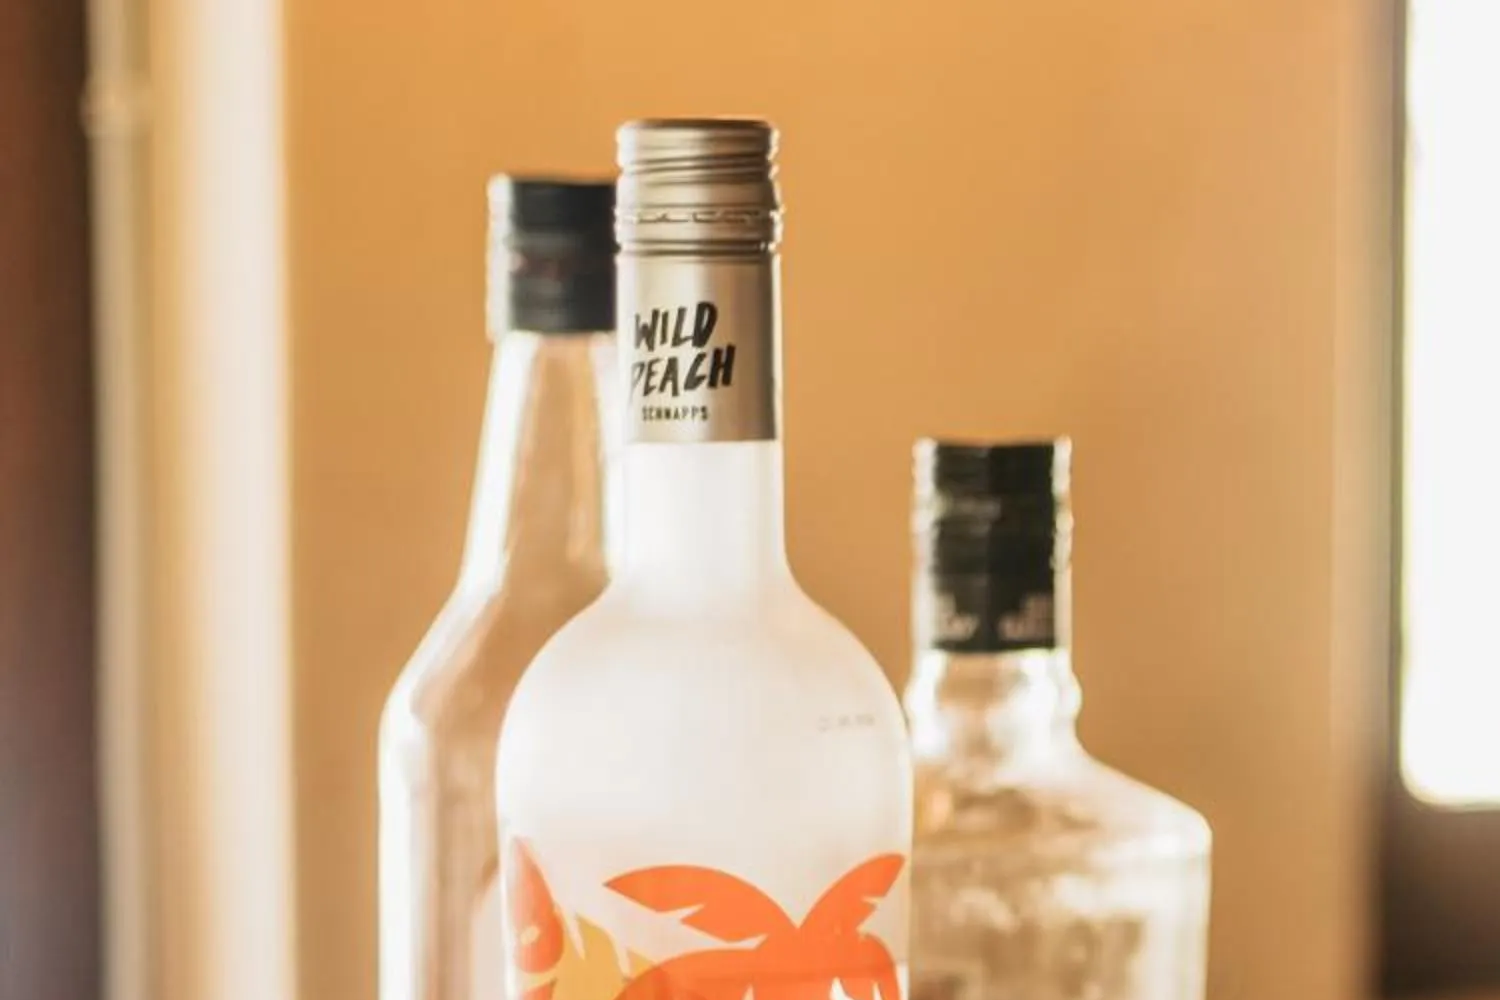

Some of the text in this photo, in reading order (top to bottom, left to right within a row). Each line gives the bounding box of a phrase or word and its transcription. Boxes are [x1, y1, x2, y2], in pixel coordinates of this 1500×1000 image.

[634, 301, 718, 351] WILD
[628, 345, 736, 404] PEACH
[641, 405, 708, 421] SCHNAPPS
